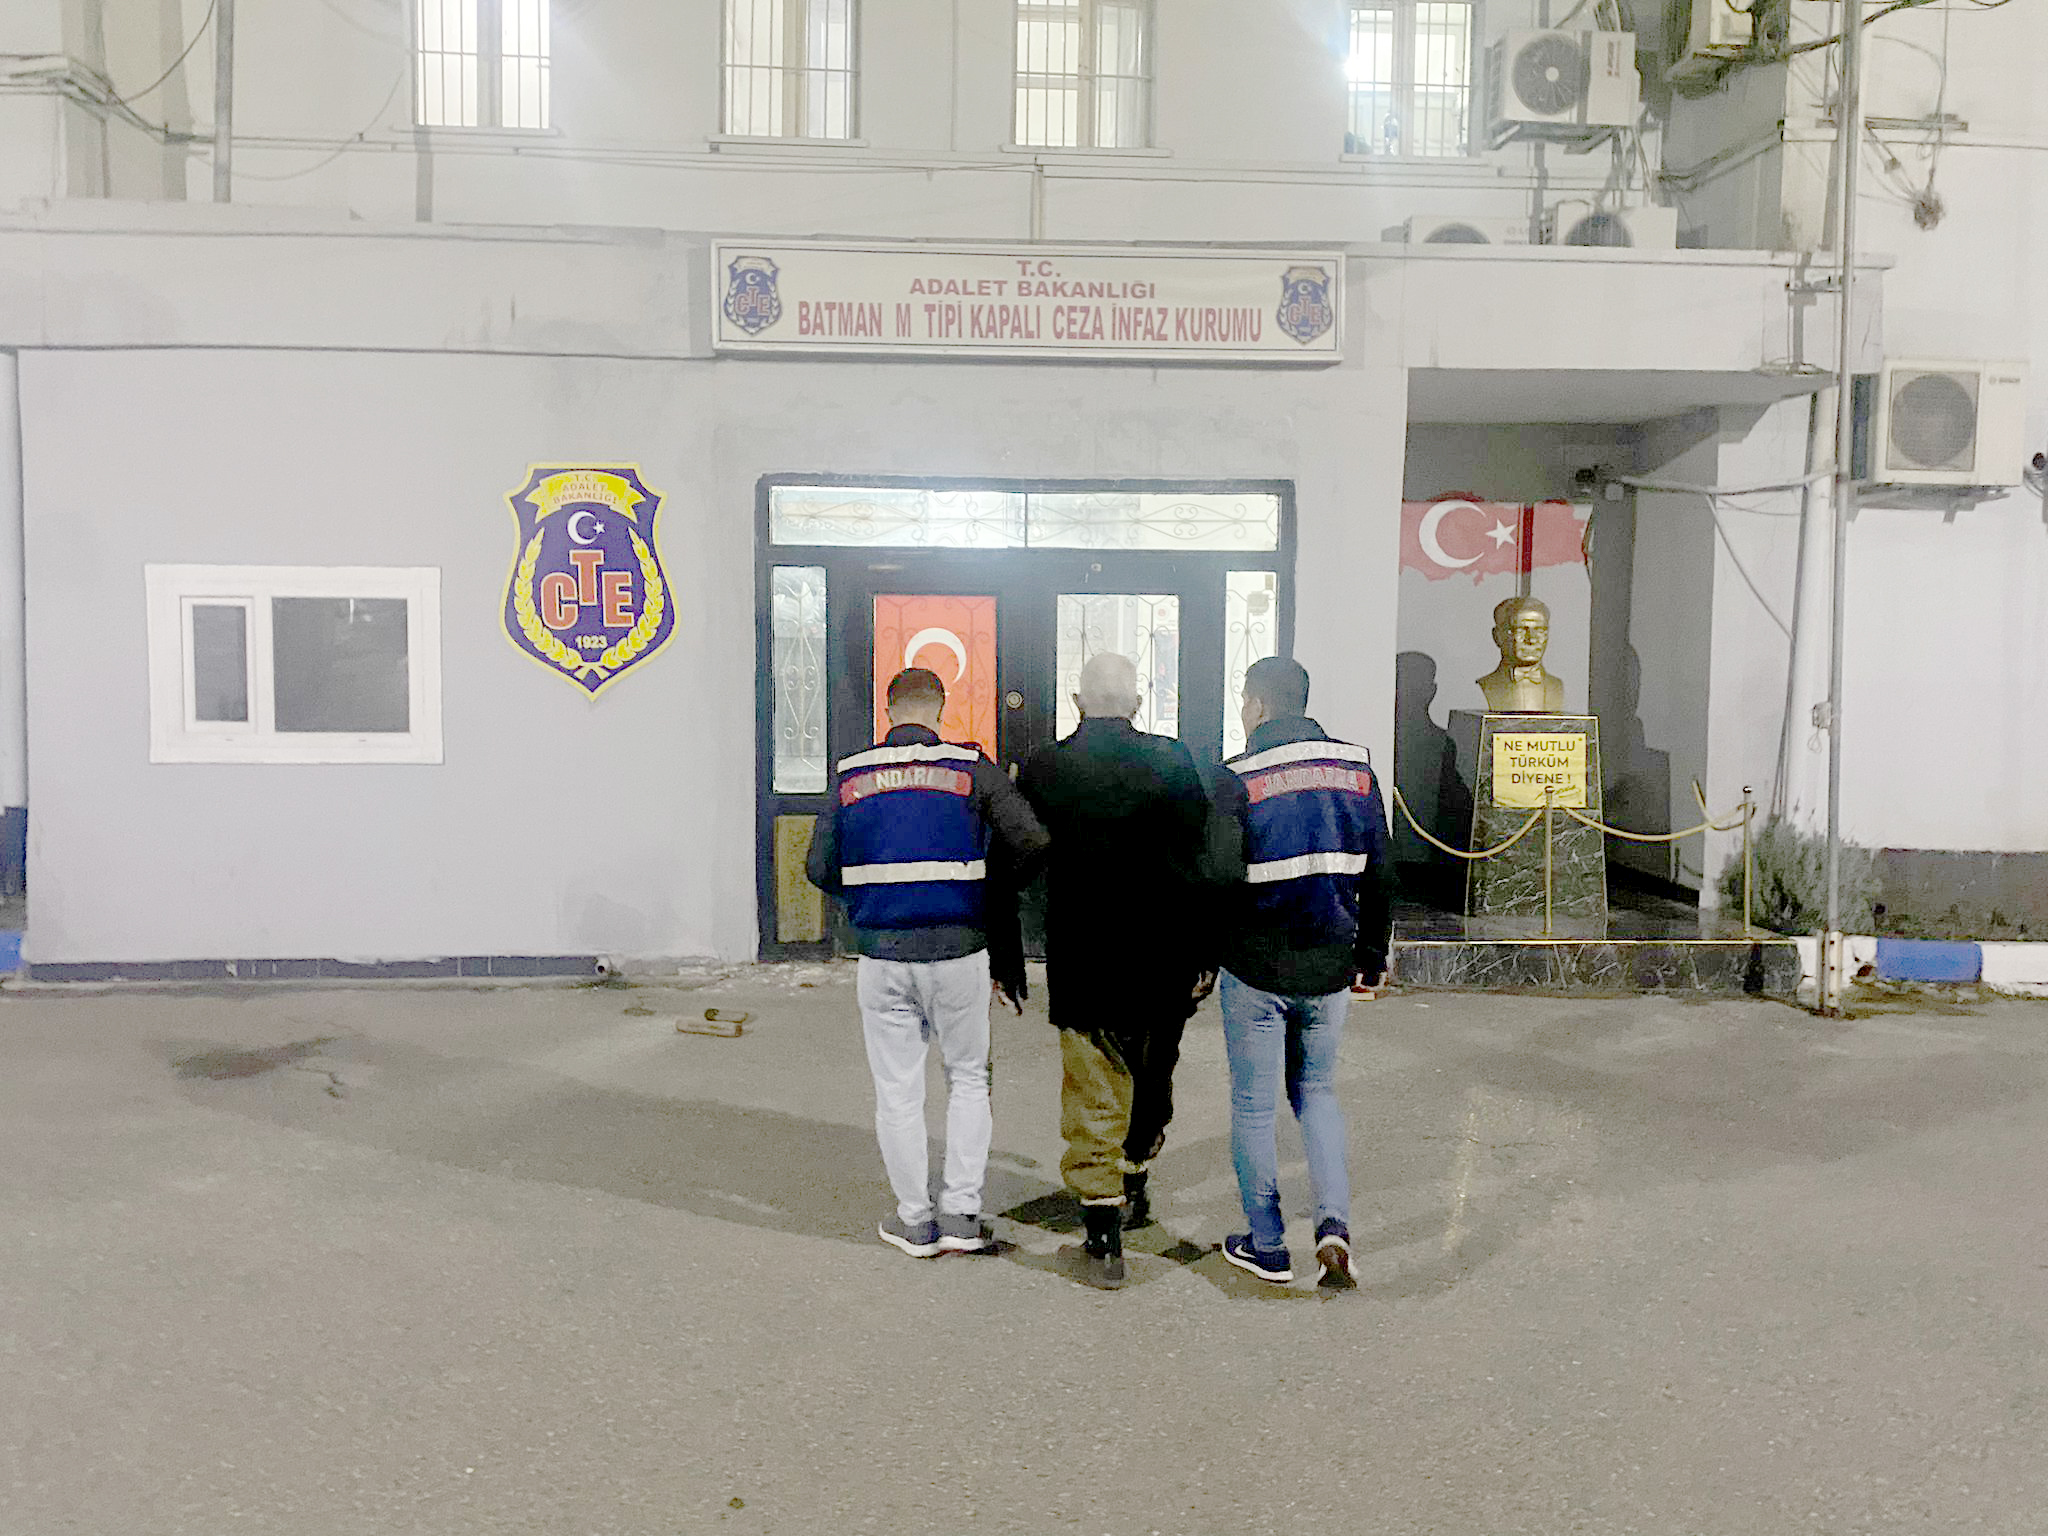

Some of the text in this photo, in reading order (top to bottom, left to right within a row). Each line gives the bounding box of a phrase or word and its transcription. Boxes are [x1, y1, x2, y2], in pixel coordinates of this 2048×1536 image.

[1016, 260, 1061, 277] T.C.
[909, 278, 1156, 299] ADALET BAKANLIĞI
[798, 300, 1262, 342] BATMAN M TİPİ KAPALI CEZA İNFAZ KURUMU
[562, 482, 606, 492] ADALET
[574, 635, 608, 649] 1923
[1503, 740, 1576, 752] NE MUTLU
[1510, 754, 1569, 768] TÜRKÜM
[1511, 770, 1564, 784] DİYENE
